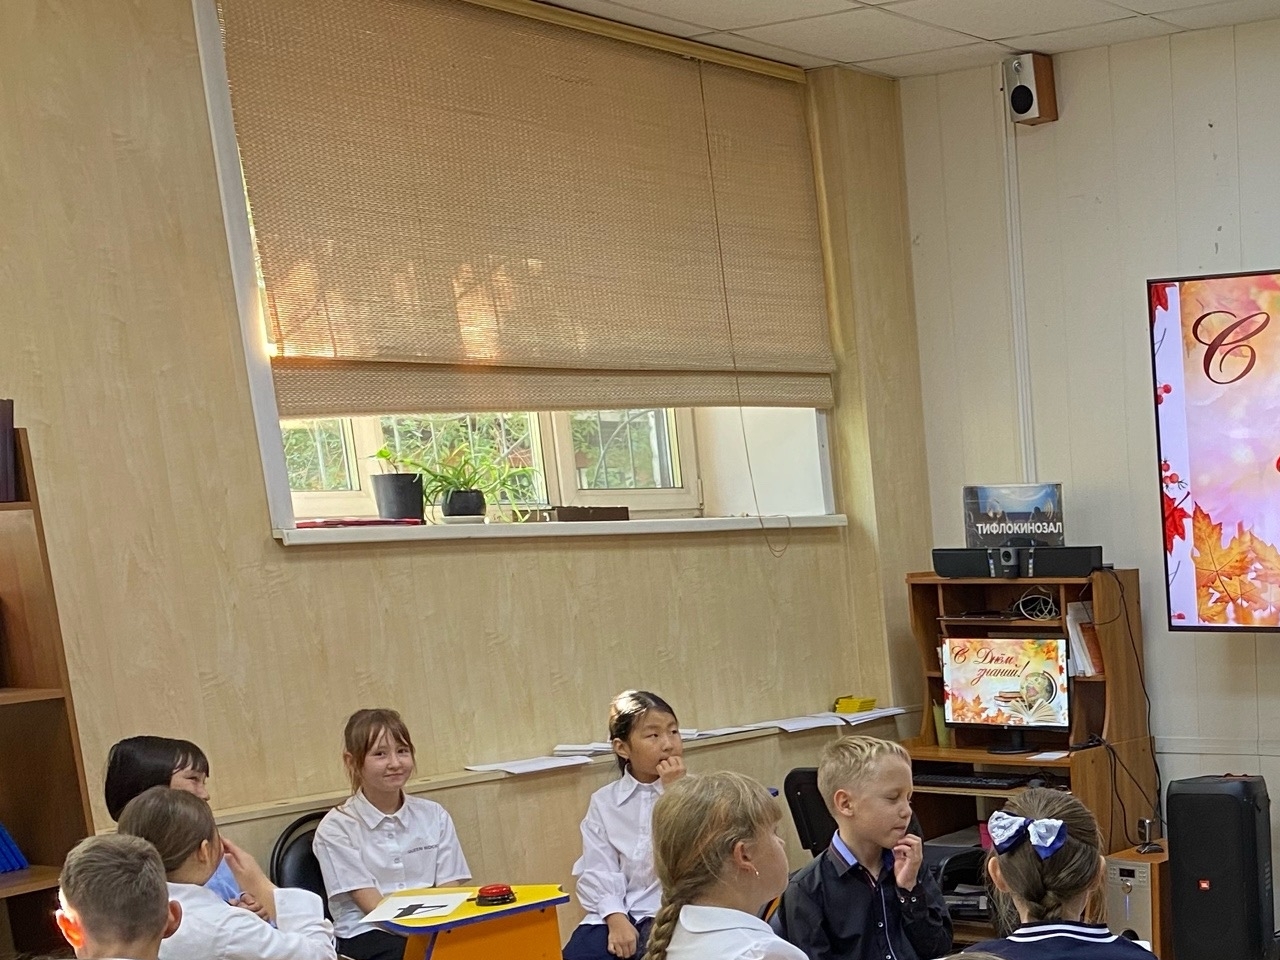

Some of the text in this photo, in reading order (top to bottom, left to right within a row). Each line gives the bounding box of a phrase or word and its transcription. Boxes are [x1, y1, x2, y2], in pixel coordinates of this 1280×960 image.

[1191, 310, 1271, 385] С
[976, 522, 1063, 535] ТИФЛОКИНОЗАЛ
[951, 645, 1015, 665] С Днём
